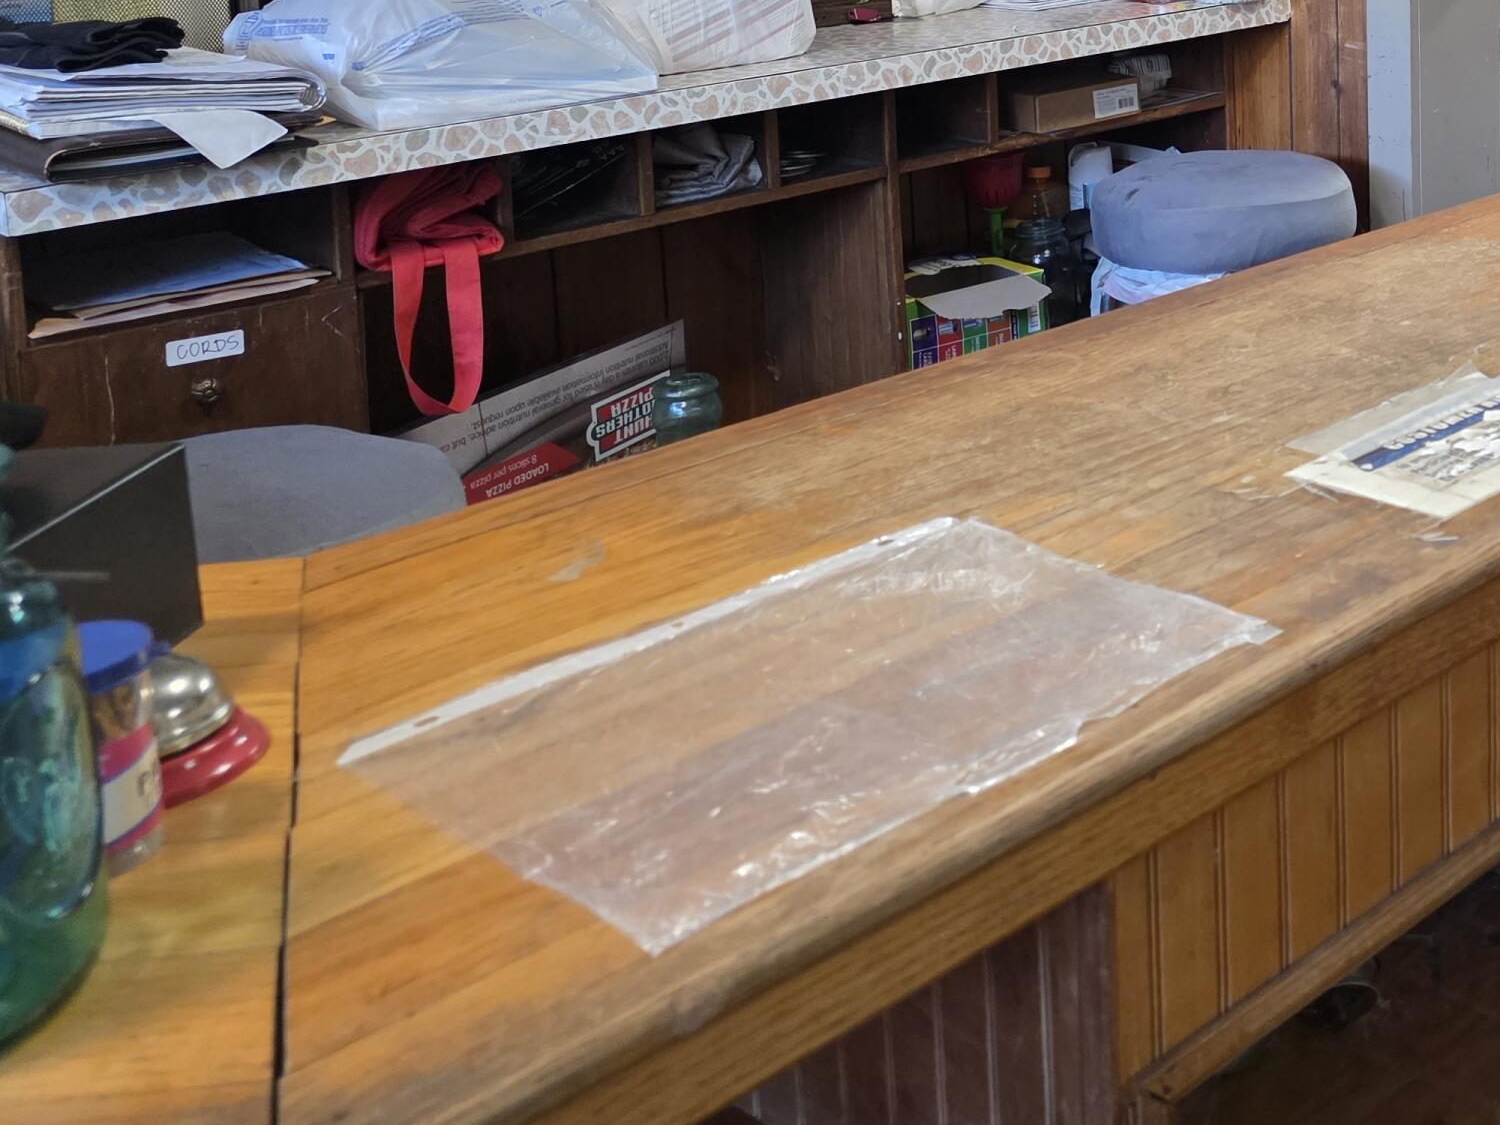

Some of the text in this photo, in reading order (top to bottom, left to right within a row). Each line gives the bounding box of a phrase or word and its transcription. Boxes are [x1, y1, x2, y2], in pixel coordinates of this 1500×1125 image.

[175, 331, 242, 361] CORDS
[635, 340, 670, 362] Additional
[604, 354, 635, 375] nutrition
[562, 367, 605, 392] information
[574, 382, 593, 398] used
[505, 397, 527, 416] upon
[526, 385, 562, 406] available
[532, 393, 562, 414] general
[562, 389, 574, 402] for
[611, 387, 655, 418] PIZZA
[499, 405, 532, 427] nutrition
[595, 399, 655, 438] OTHERS
[452, 434, 467, 448] but
[469, 454, 538, 489] 8 slices per pizza
[485, 462, 550, 498] LOADED PIZZA
